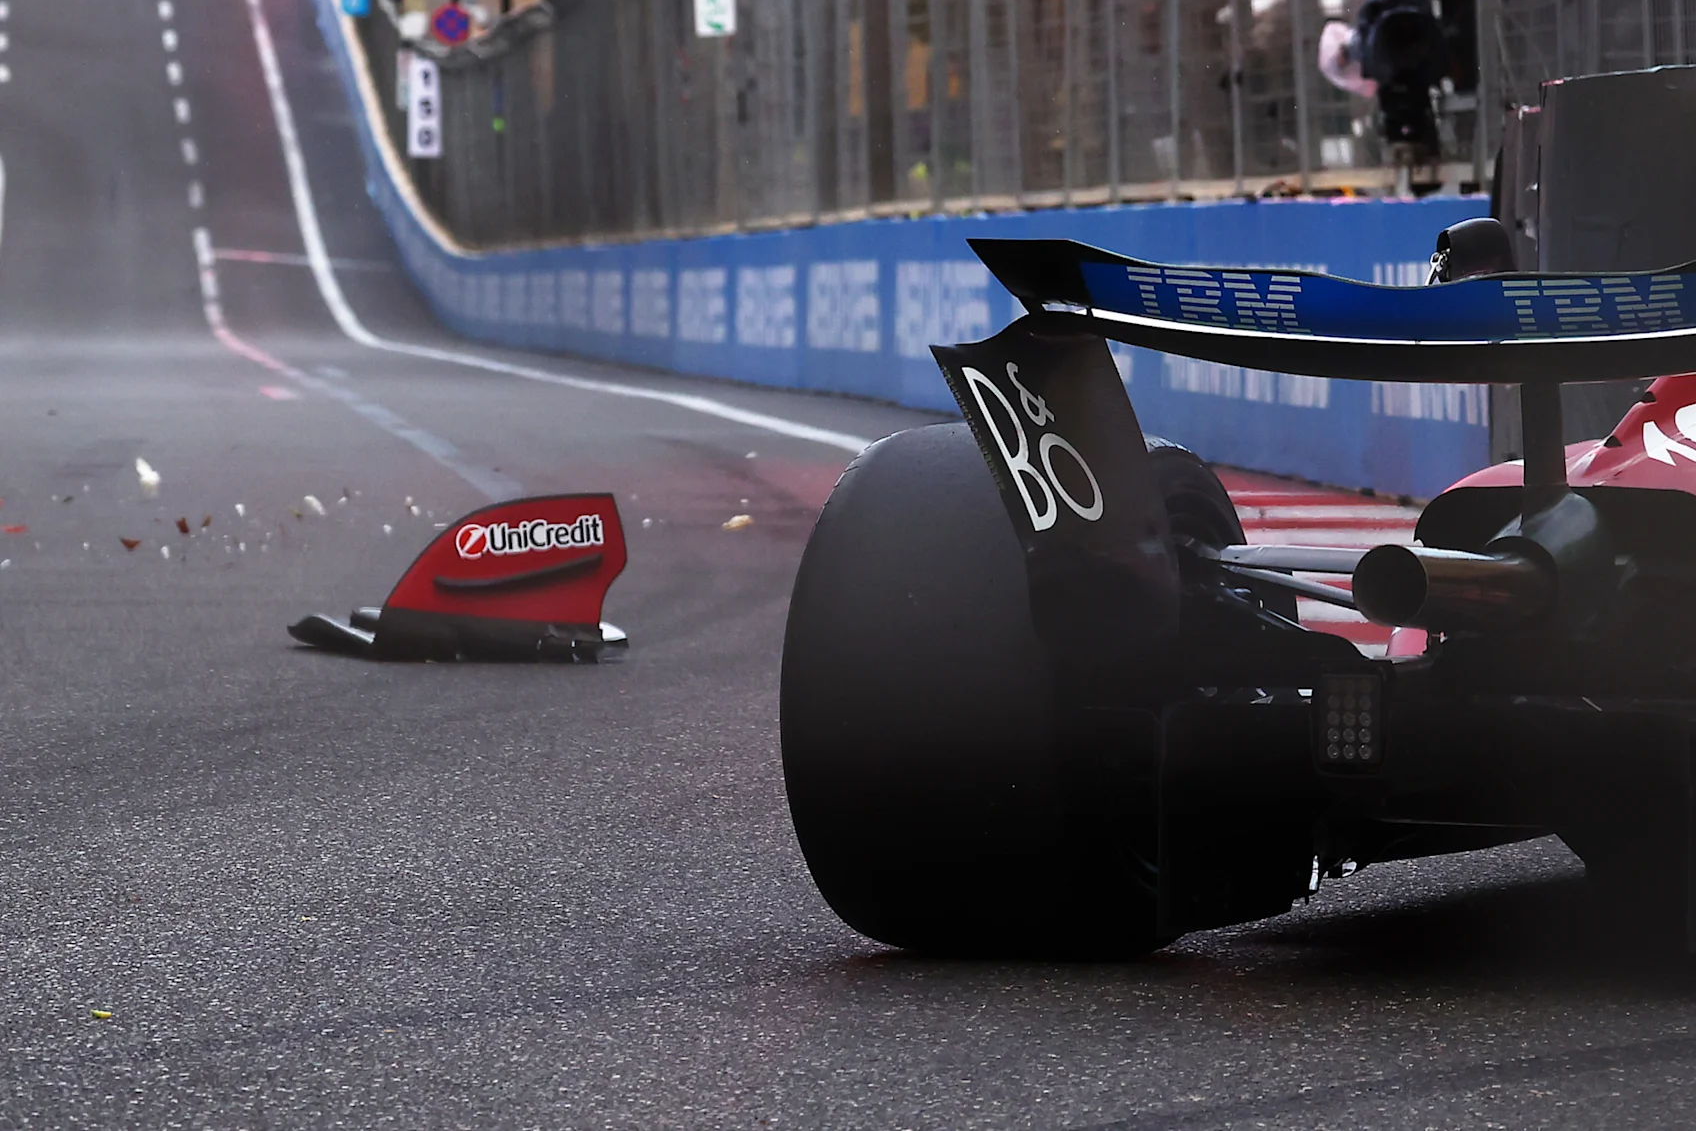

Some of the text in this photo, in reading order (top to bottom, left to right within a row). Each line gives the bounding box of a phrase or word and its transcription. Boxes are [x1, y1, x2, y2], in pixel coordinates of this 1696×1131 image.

[1125, 266, 1312, 336] IBM
[1501, 275, 1688, 339] IBM
[489, 515, 602, 553] UniCredit
